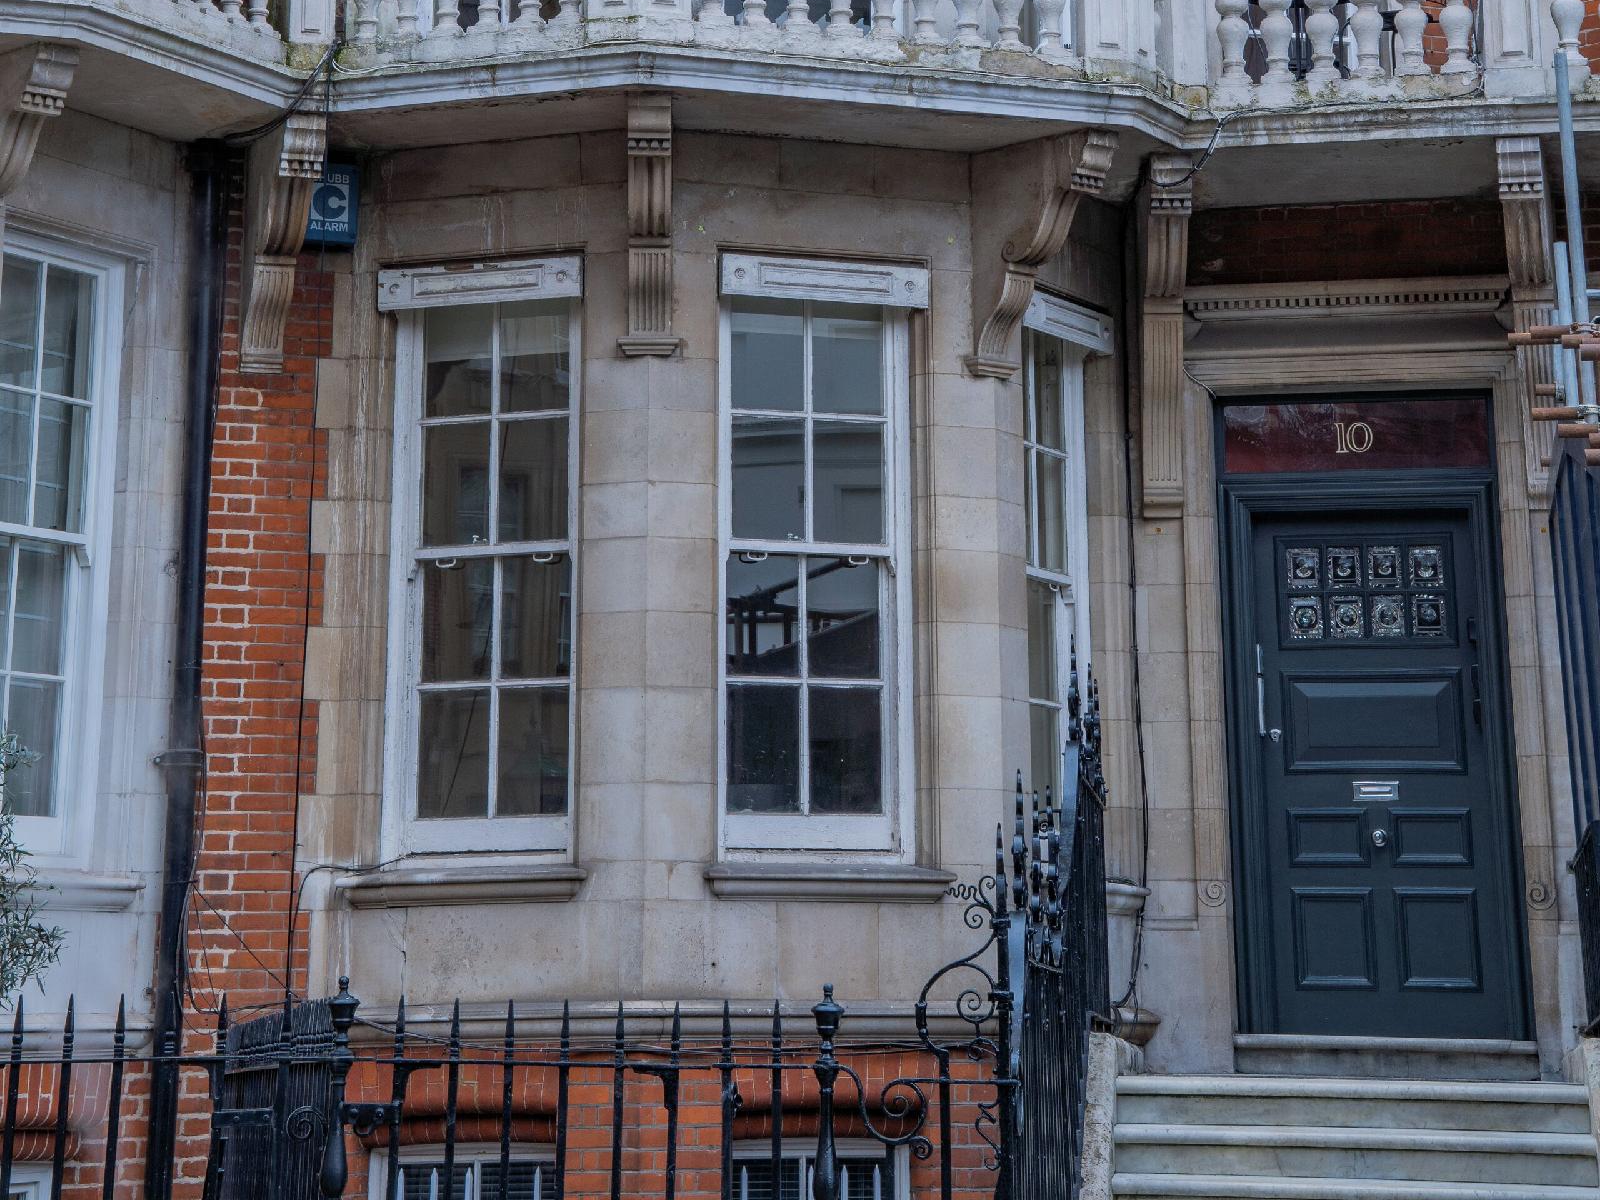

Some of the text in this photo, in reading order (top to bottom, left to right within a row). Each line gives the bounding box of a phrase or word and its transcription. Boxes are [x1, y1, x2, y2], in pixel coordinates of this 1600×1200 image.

[318, 173, 350, 184] UBB
[310, 220, 349, 232] ALARM
[1333, 422, 1374, 454] 10
